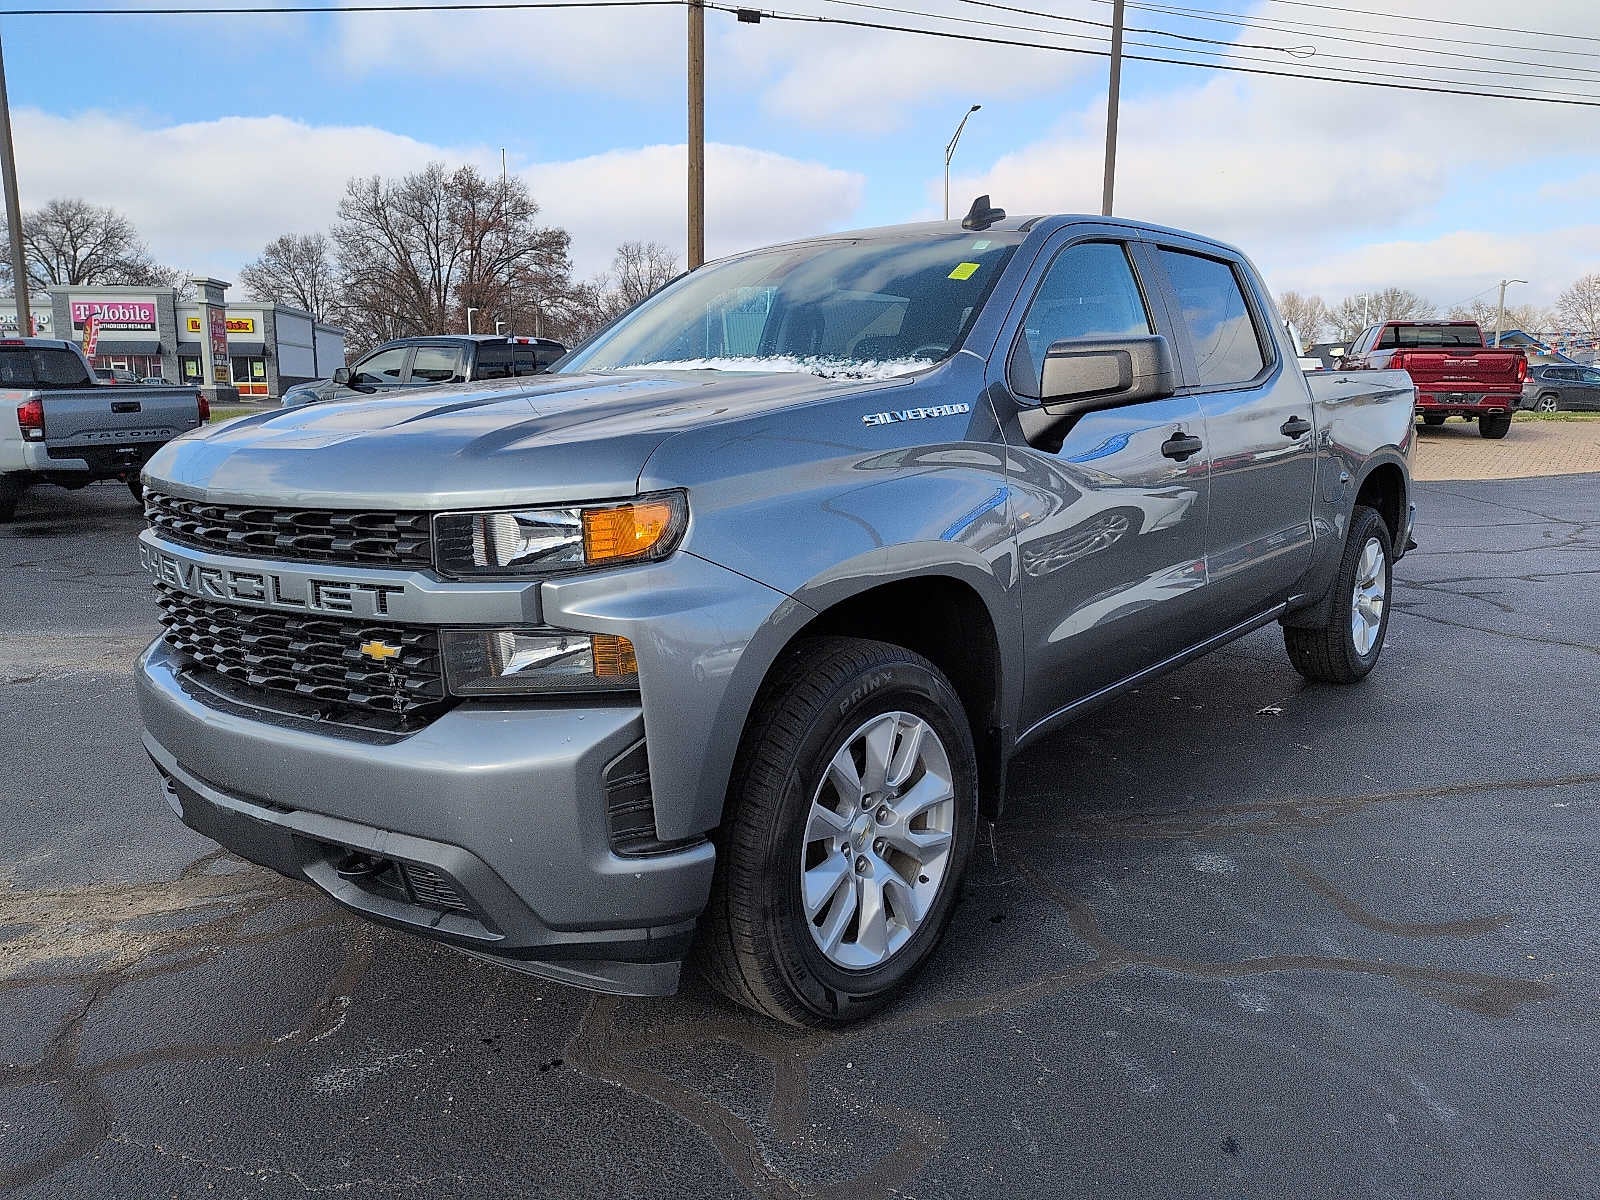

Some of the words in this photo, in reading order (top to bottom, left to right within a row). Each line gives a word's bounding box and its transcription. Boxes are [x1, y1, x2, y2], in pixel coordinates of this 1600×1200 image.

[862, 402, 970, 426] SILVERADO
[83, 429, 171, 439] TACOMA
[139, 543, 405, 617] CHEVROLET
